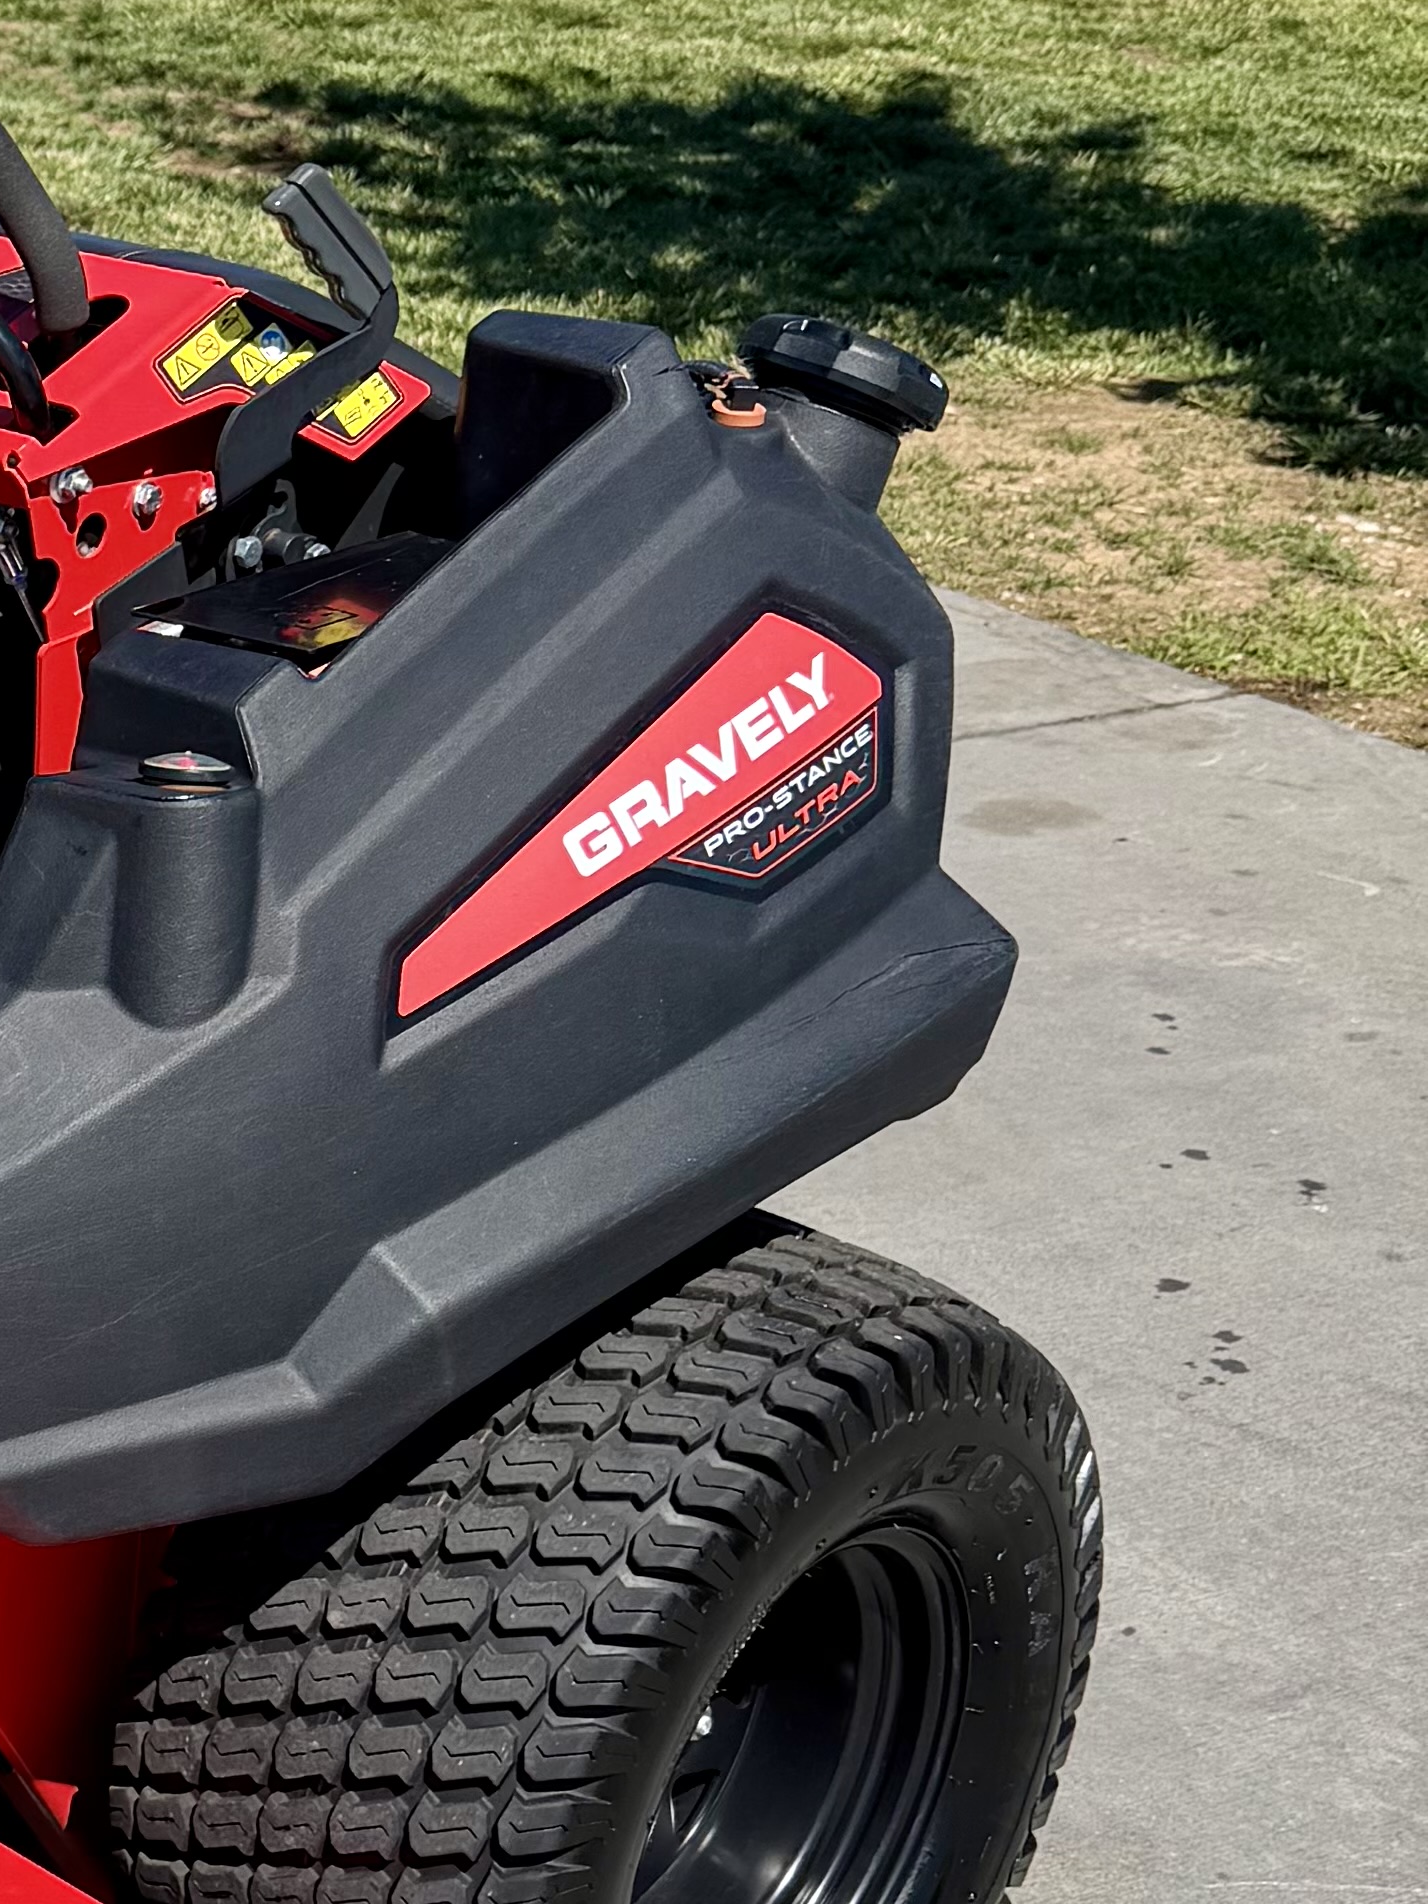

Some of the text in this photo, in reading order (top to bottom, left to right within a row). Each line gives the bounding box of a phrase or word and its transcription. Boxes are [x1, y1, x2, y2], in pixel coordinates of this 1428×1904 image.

[562, 652, 832, 877] GRAVELY
[703, 723, 874, 859] PRO-STANCE
[752, 770, 862, 860] ULTRA
